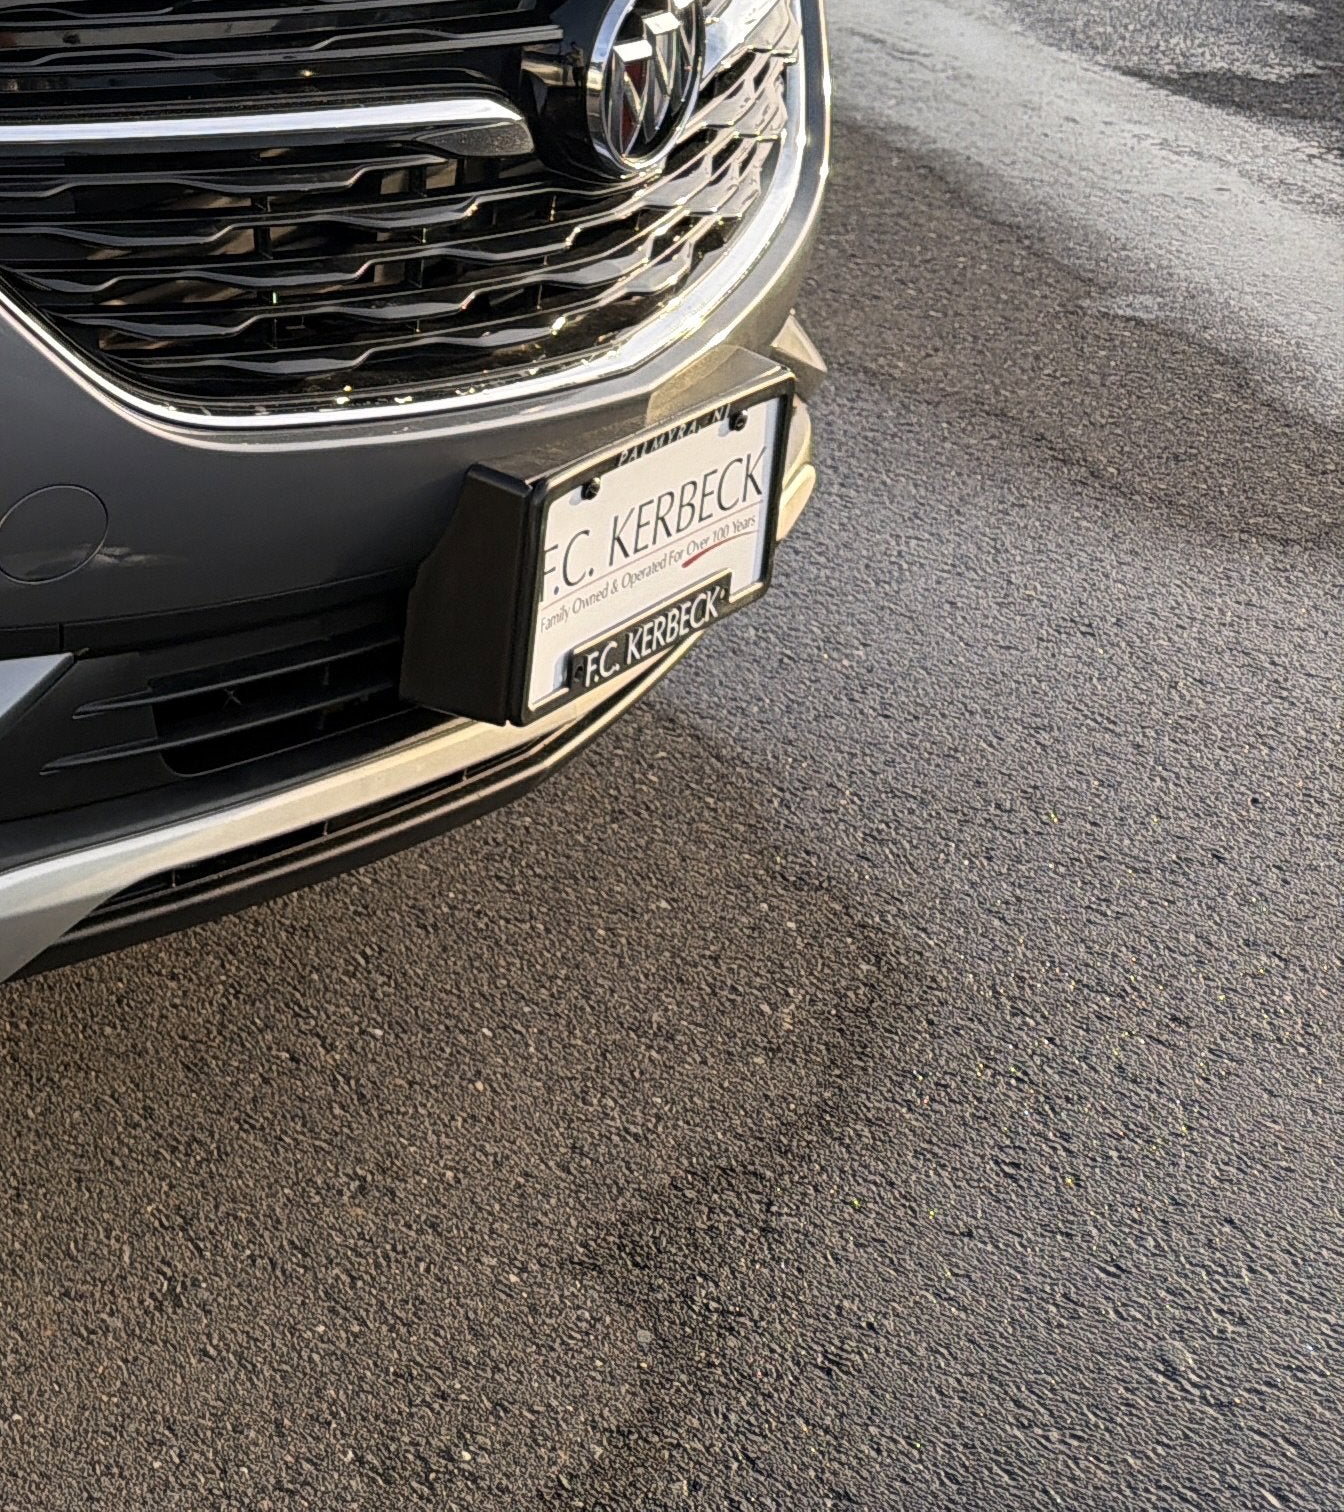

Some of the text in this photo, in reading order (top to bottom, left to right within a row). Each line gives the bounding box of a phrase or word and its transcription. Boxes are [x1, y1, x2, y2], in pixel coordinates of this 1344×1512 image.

[608, 446, 768, 567] KERBECK
[540, 515, 756, 633] Family Owned & Operated For Over 100 Years
[584, 585, 720, 688] F.C. KERBECK
